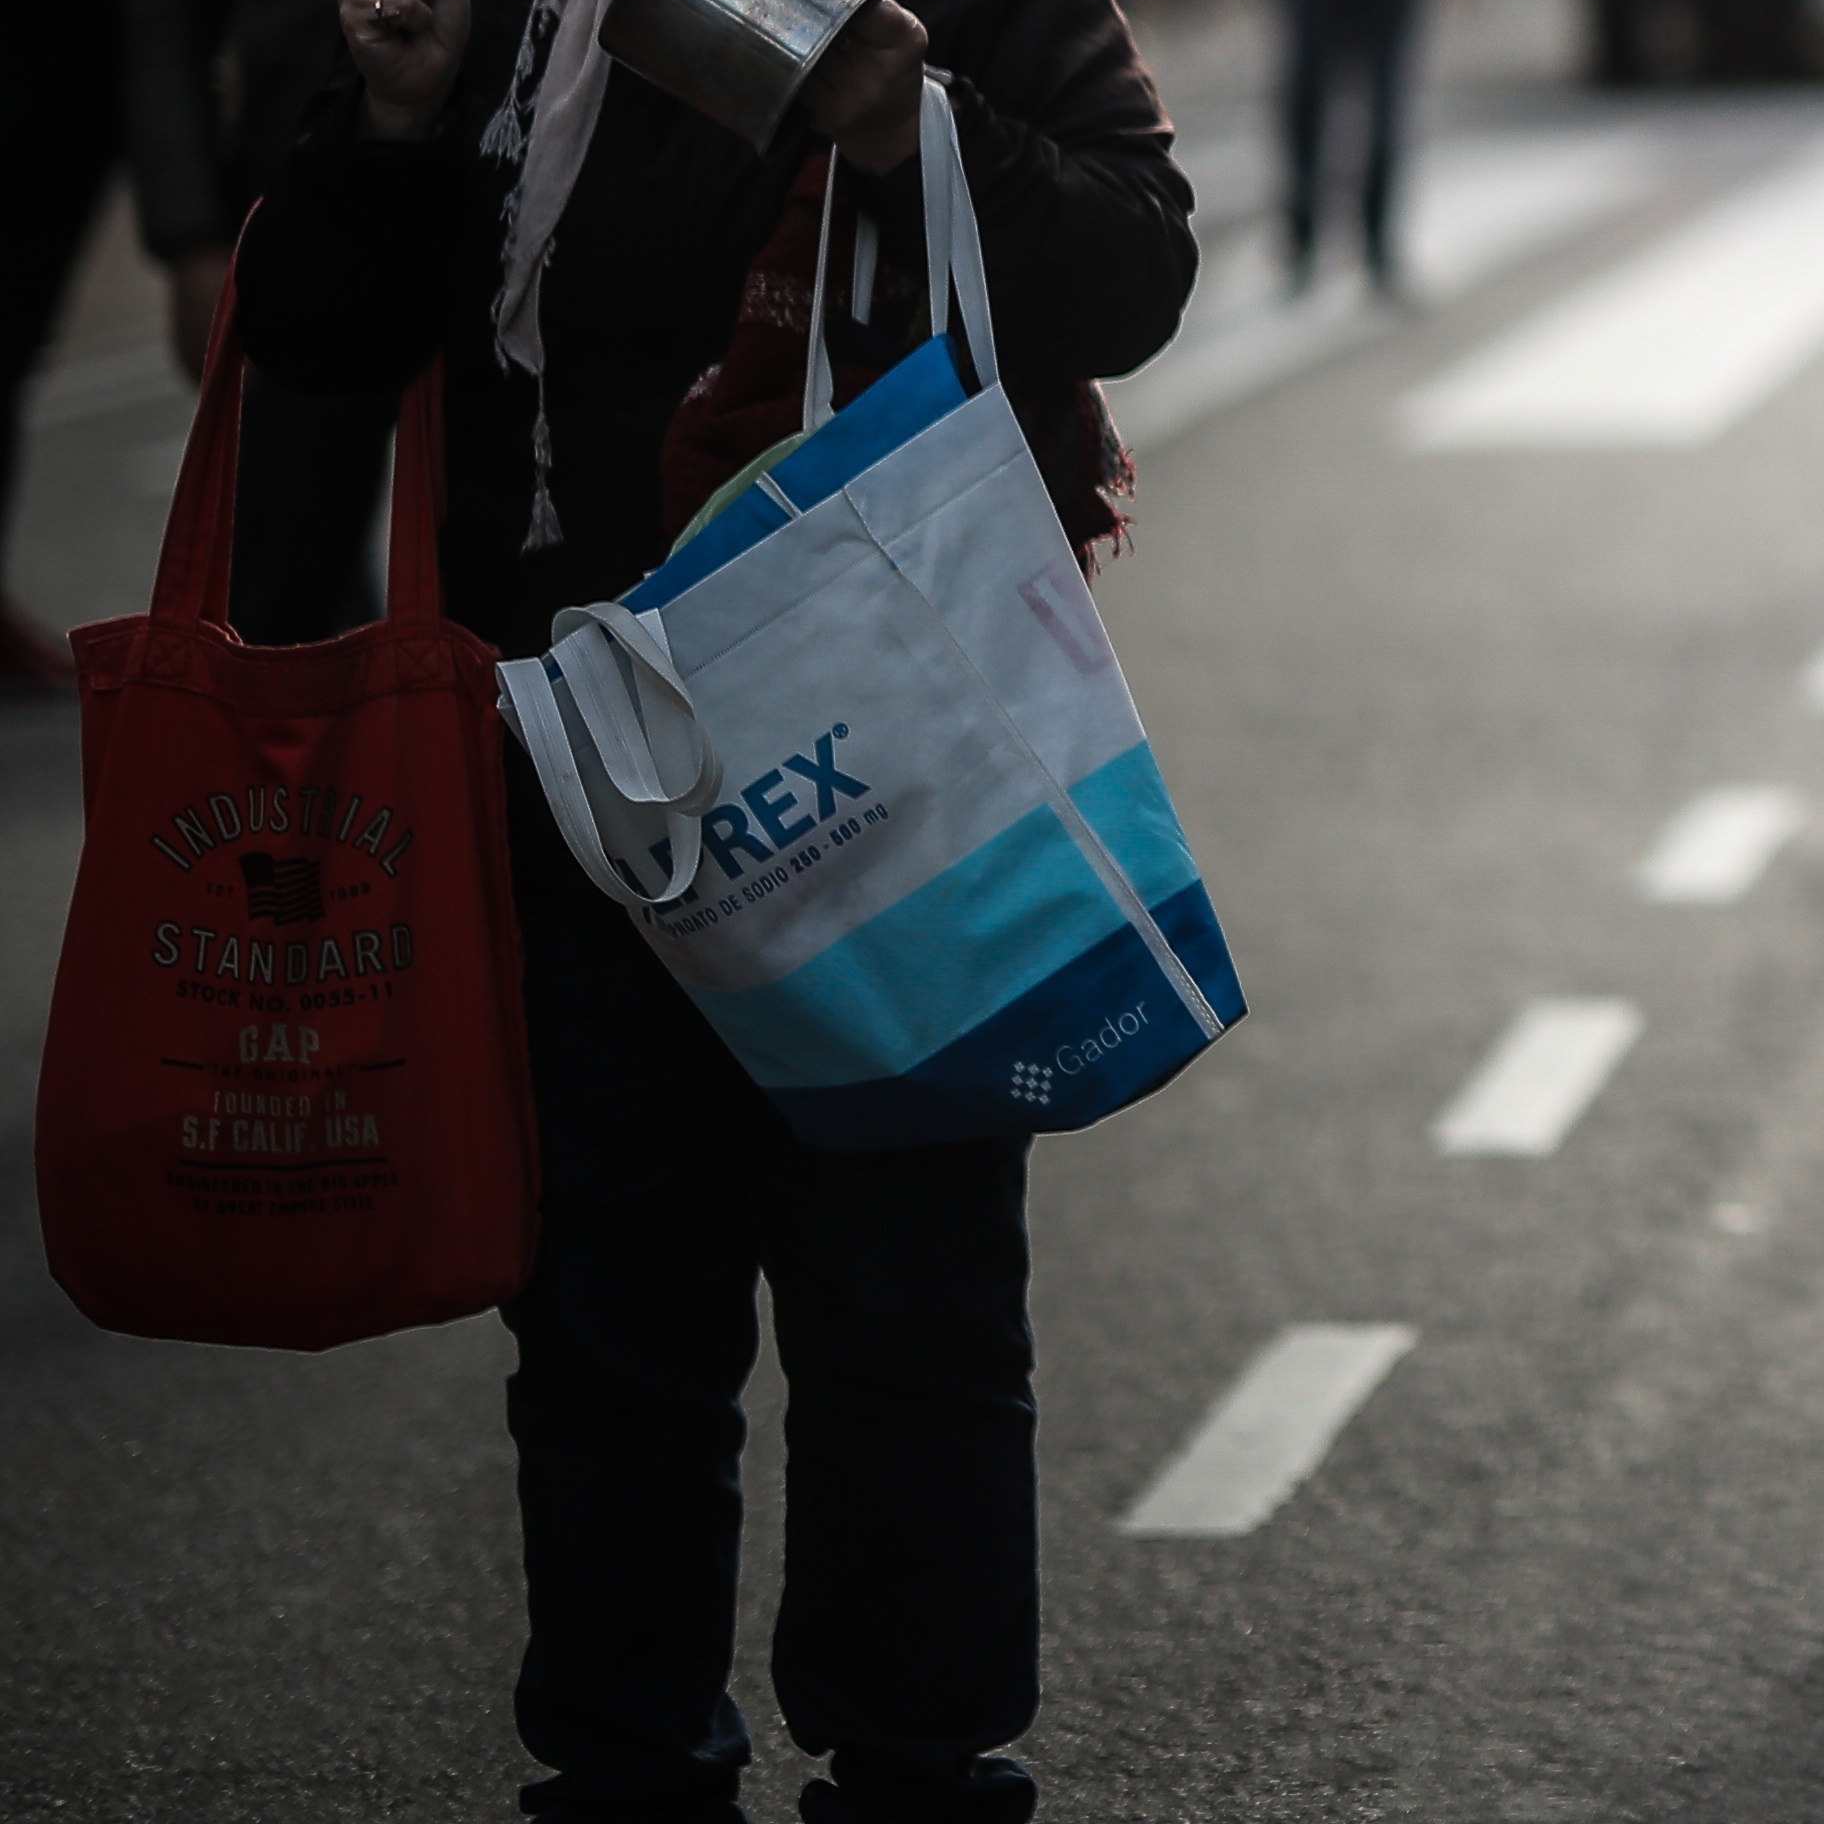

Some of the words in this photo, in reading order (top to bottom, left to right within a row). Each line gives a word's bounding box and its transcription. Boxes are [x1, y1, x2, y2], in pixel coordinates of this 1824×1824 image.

[151, 785, 414, 878] INDUSTRIAL
[719, 894, 743, 917] DE
[742, 865, 790, 903] SODIO
[789, 845, 822, 874] 250
[830, 820, 863, 848] 500
[864, 802, 890, 827] mg
[151, 920, 415, 987] STANDARD
[175, 979, 242, 1008] STOCK
[248, 992, 292, 1014] NO.
[299, 982, 394, 1011] 0055-11
[238, 1022, 321, 1065] GAP
[1055, 999, 1149, 1075] Gador
[212, 1090, 312, 1116] FOUNDED
[325, 1088, 347, 1112] IN
[181, 1113, 222, 1153] S.F
[231, 1119, 317, 1154] CALIF.
[325, 1113, 381, 1149] USA
[166, 1172, 261, 1195] ENGINEERED
[352, 1171, 399, 1189] APPLE
[215, 1199, 264, 1216] GREAT
[269, 1197, 327, 1217] EMPIRE
[332, 1195, 374, 1212] STATE
